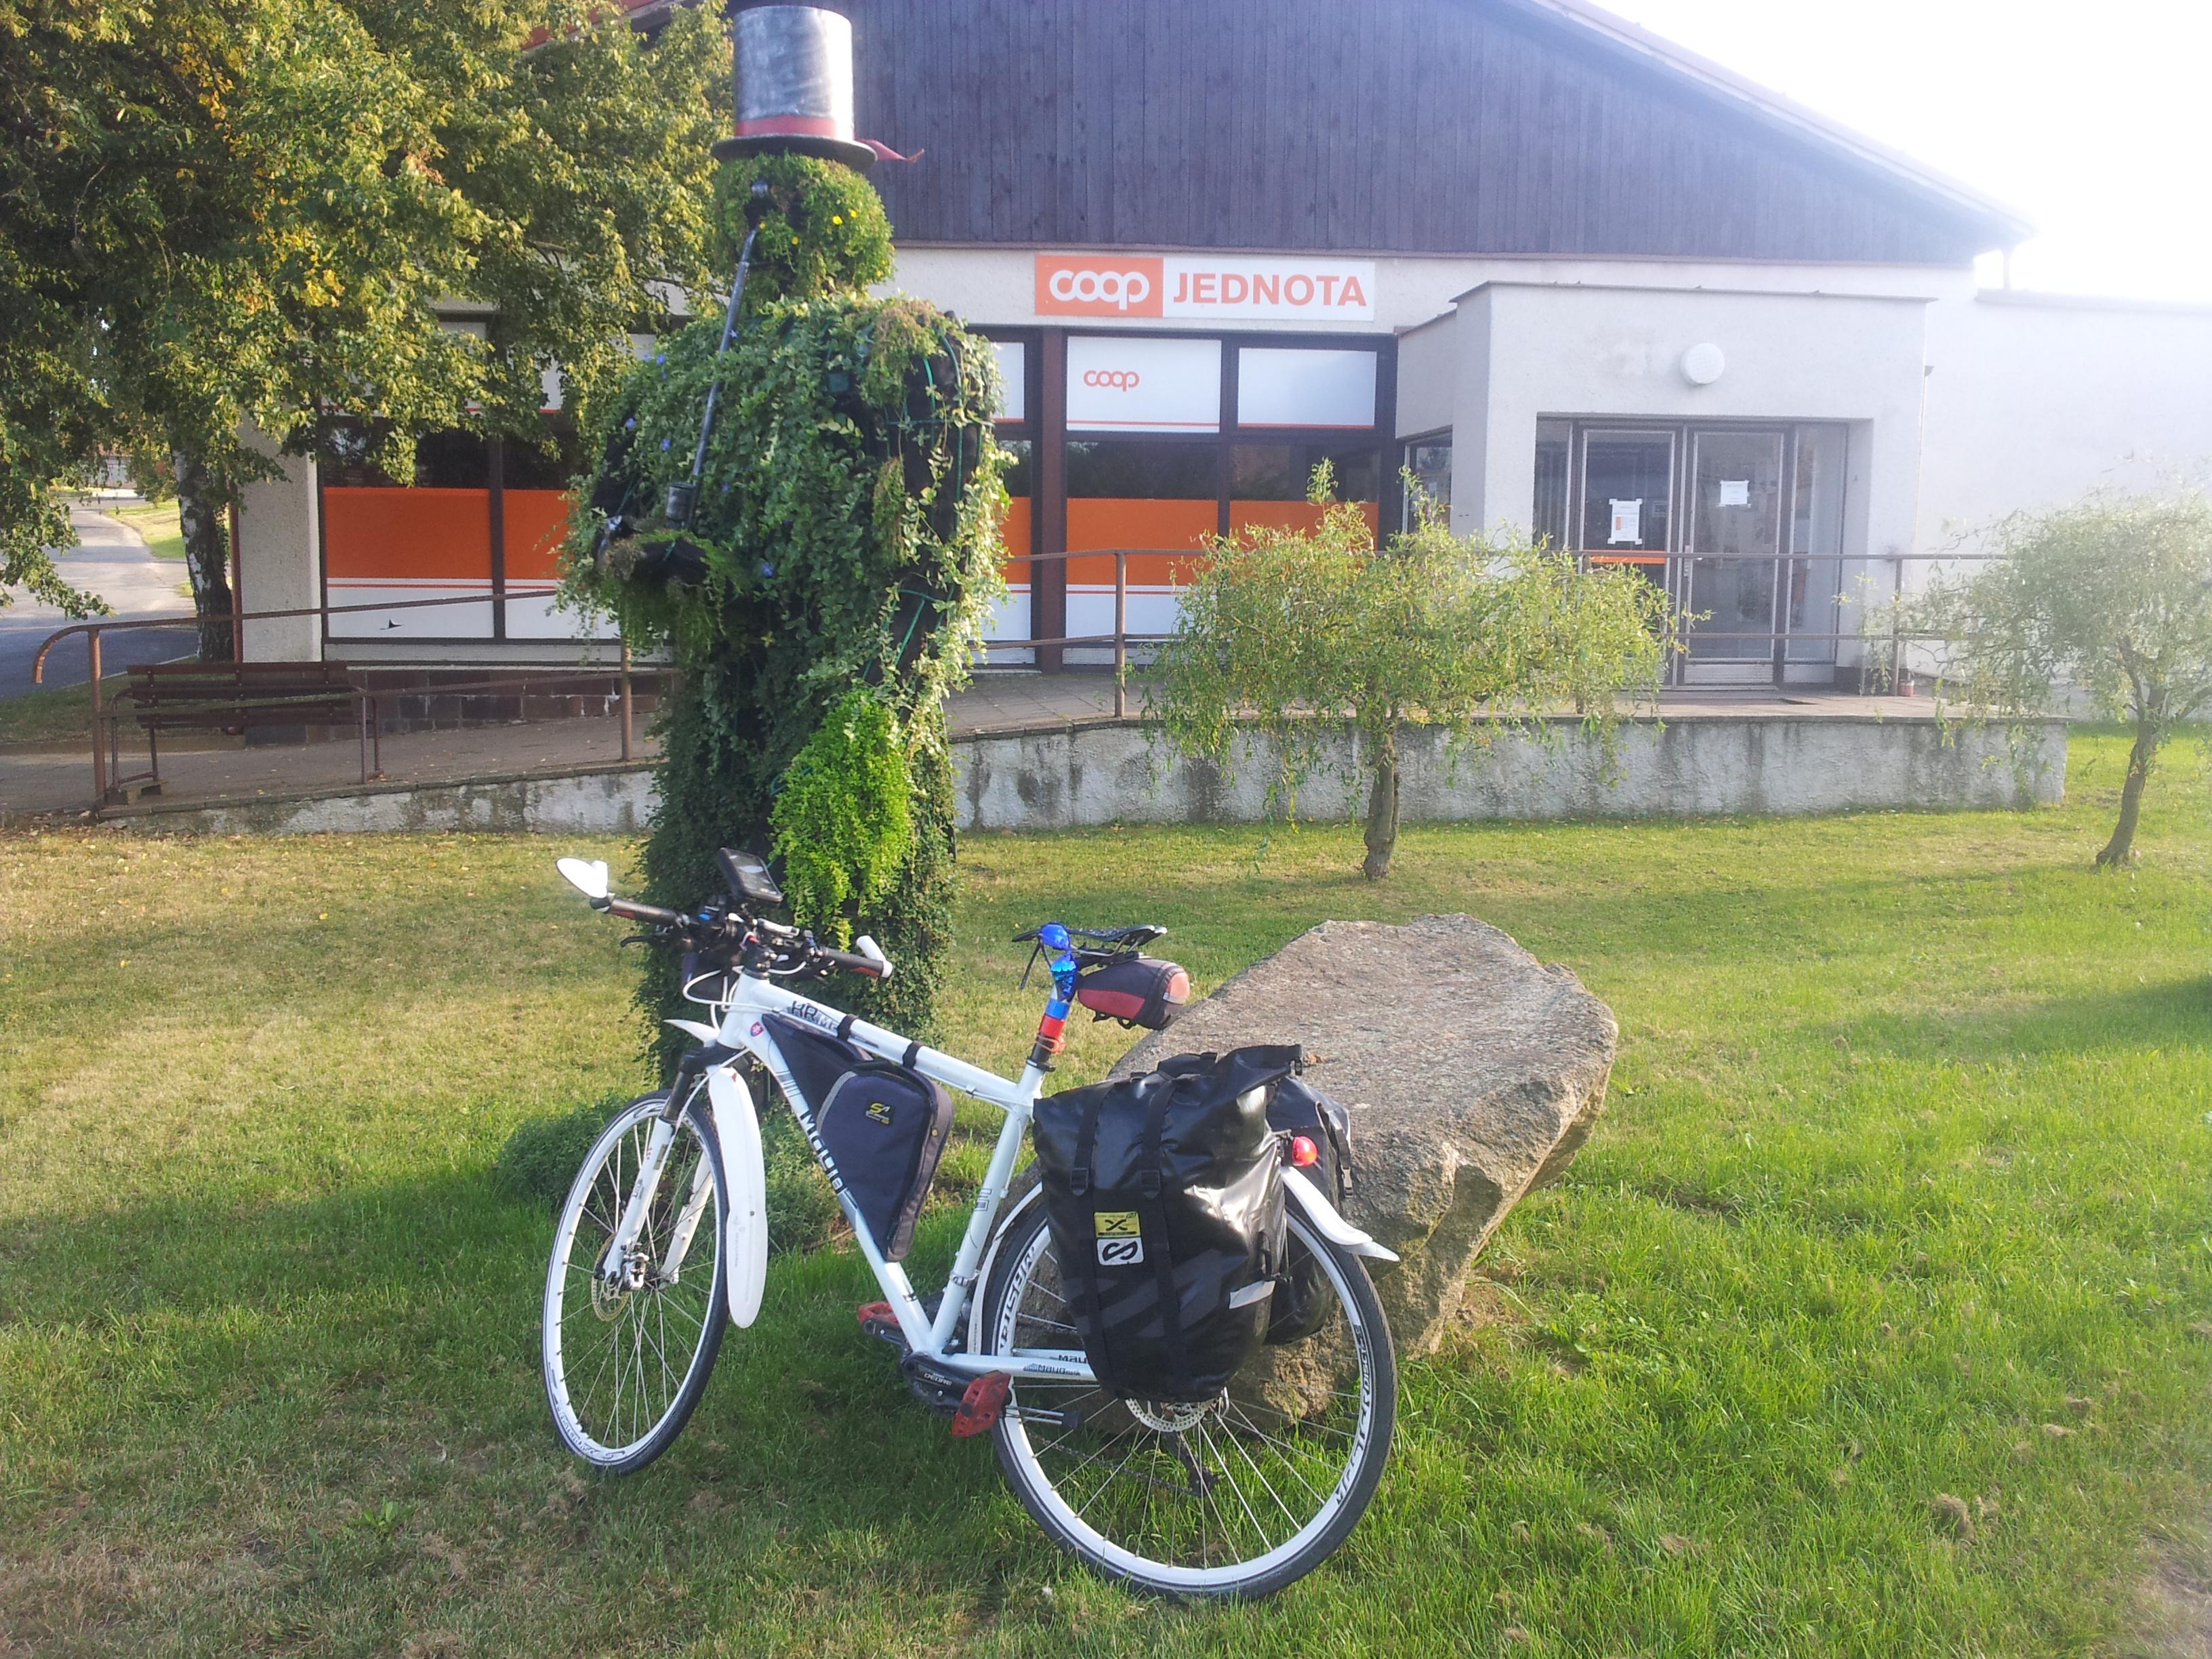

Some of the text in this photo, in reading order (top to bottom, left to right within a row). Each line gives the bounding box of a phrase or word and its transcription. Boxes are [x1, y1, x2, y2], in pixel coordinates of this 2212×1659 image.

[1049, 269, 1366, 310] coop JEDNOTA
[1084, 370, 1139, 391] coop
